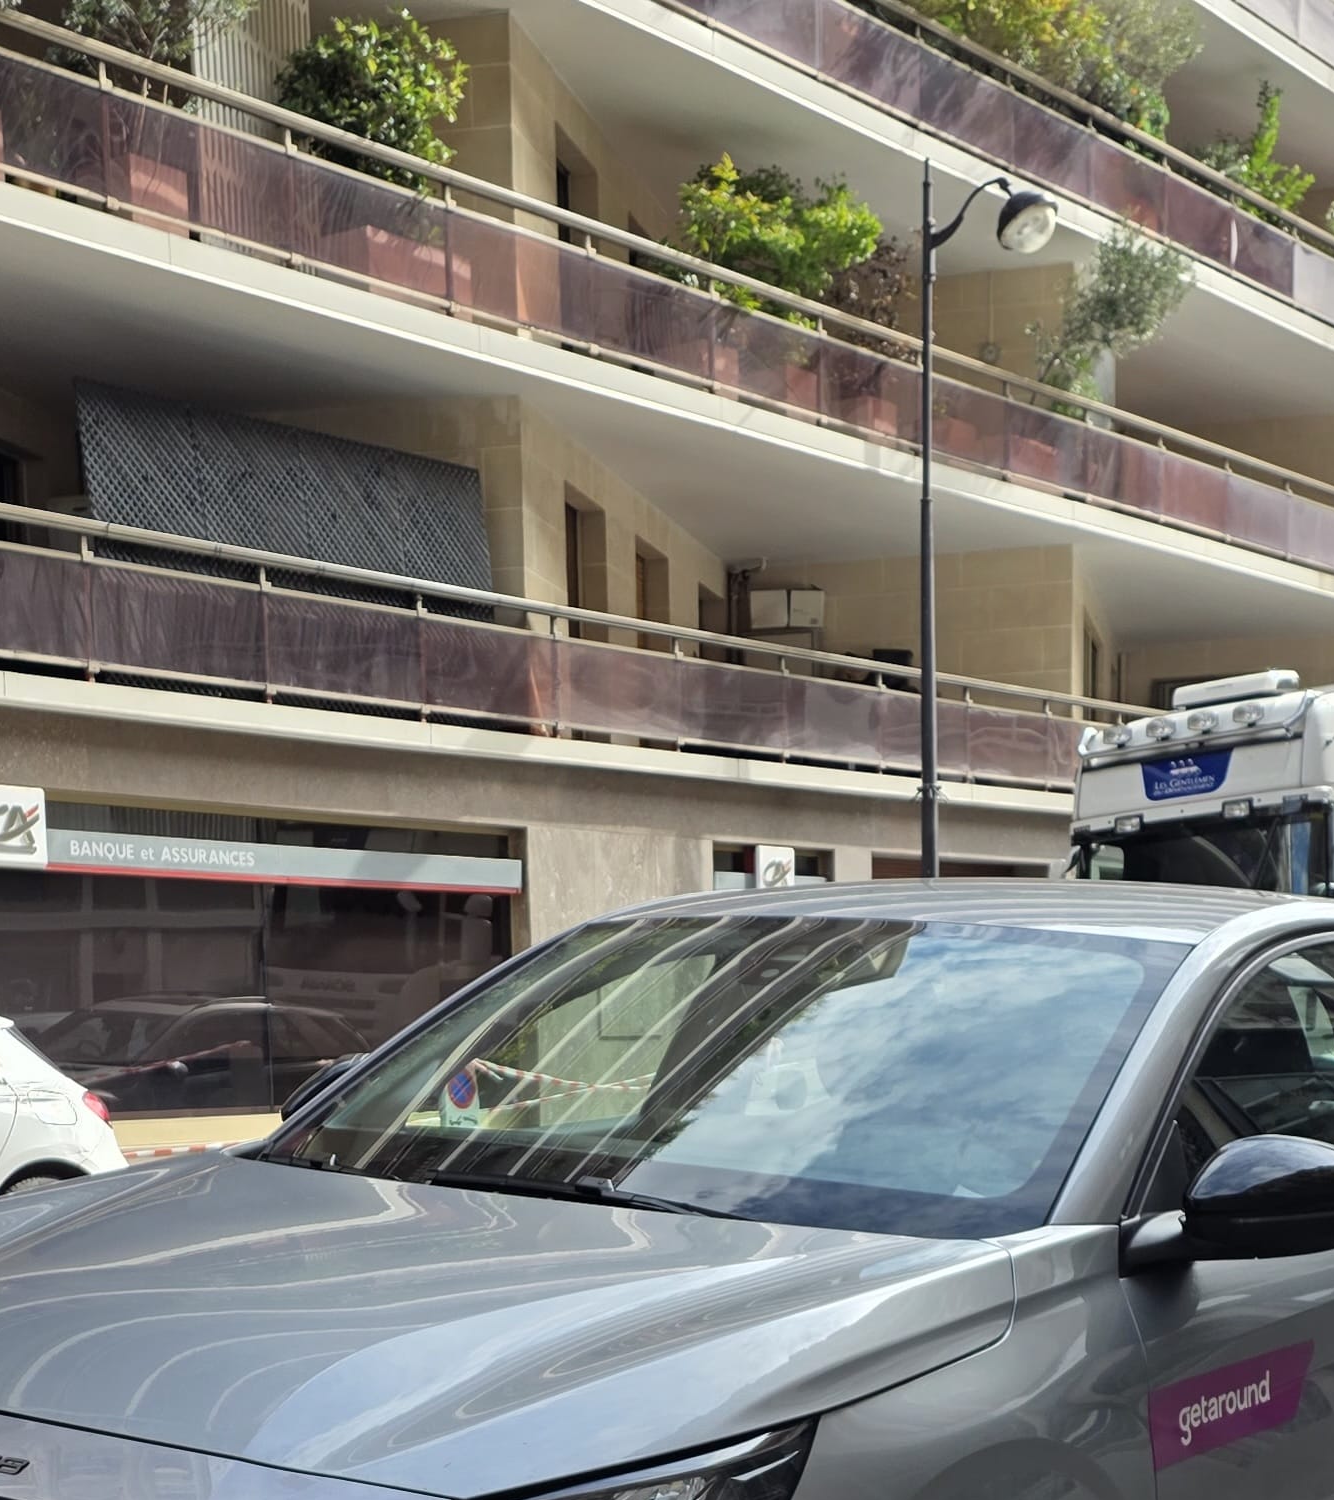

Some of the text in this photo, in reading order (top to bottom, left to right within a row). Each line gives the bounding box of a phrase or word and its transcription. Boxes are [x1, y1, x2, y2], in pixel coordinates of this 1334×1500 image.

[70, 838, 256, 868] BANQUE et ASSURANCES
[1178, 1369, 1272, 1446] getaround
